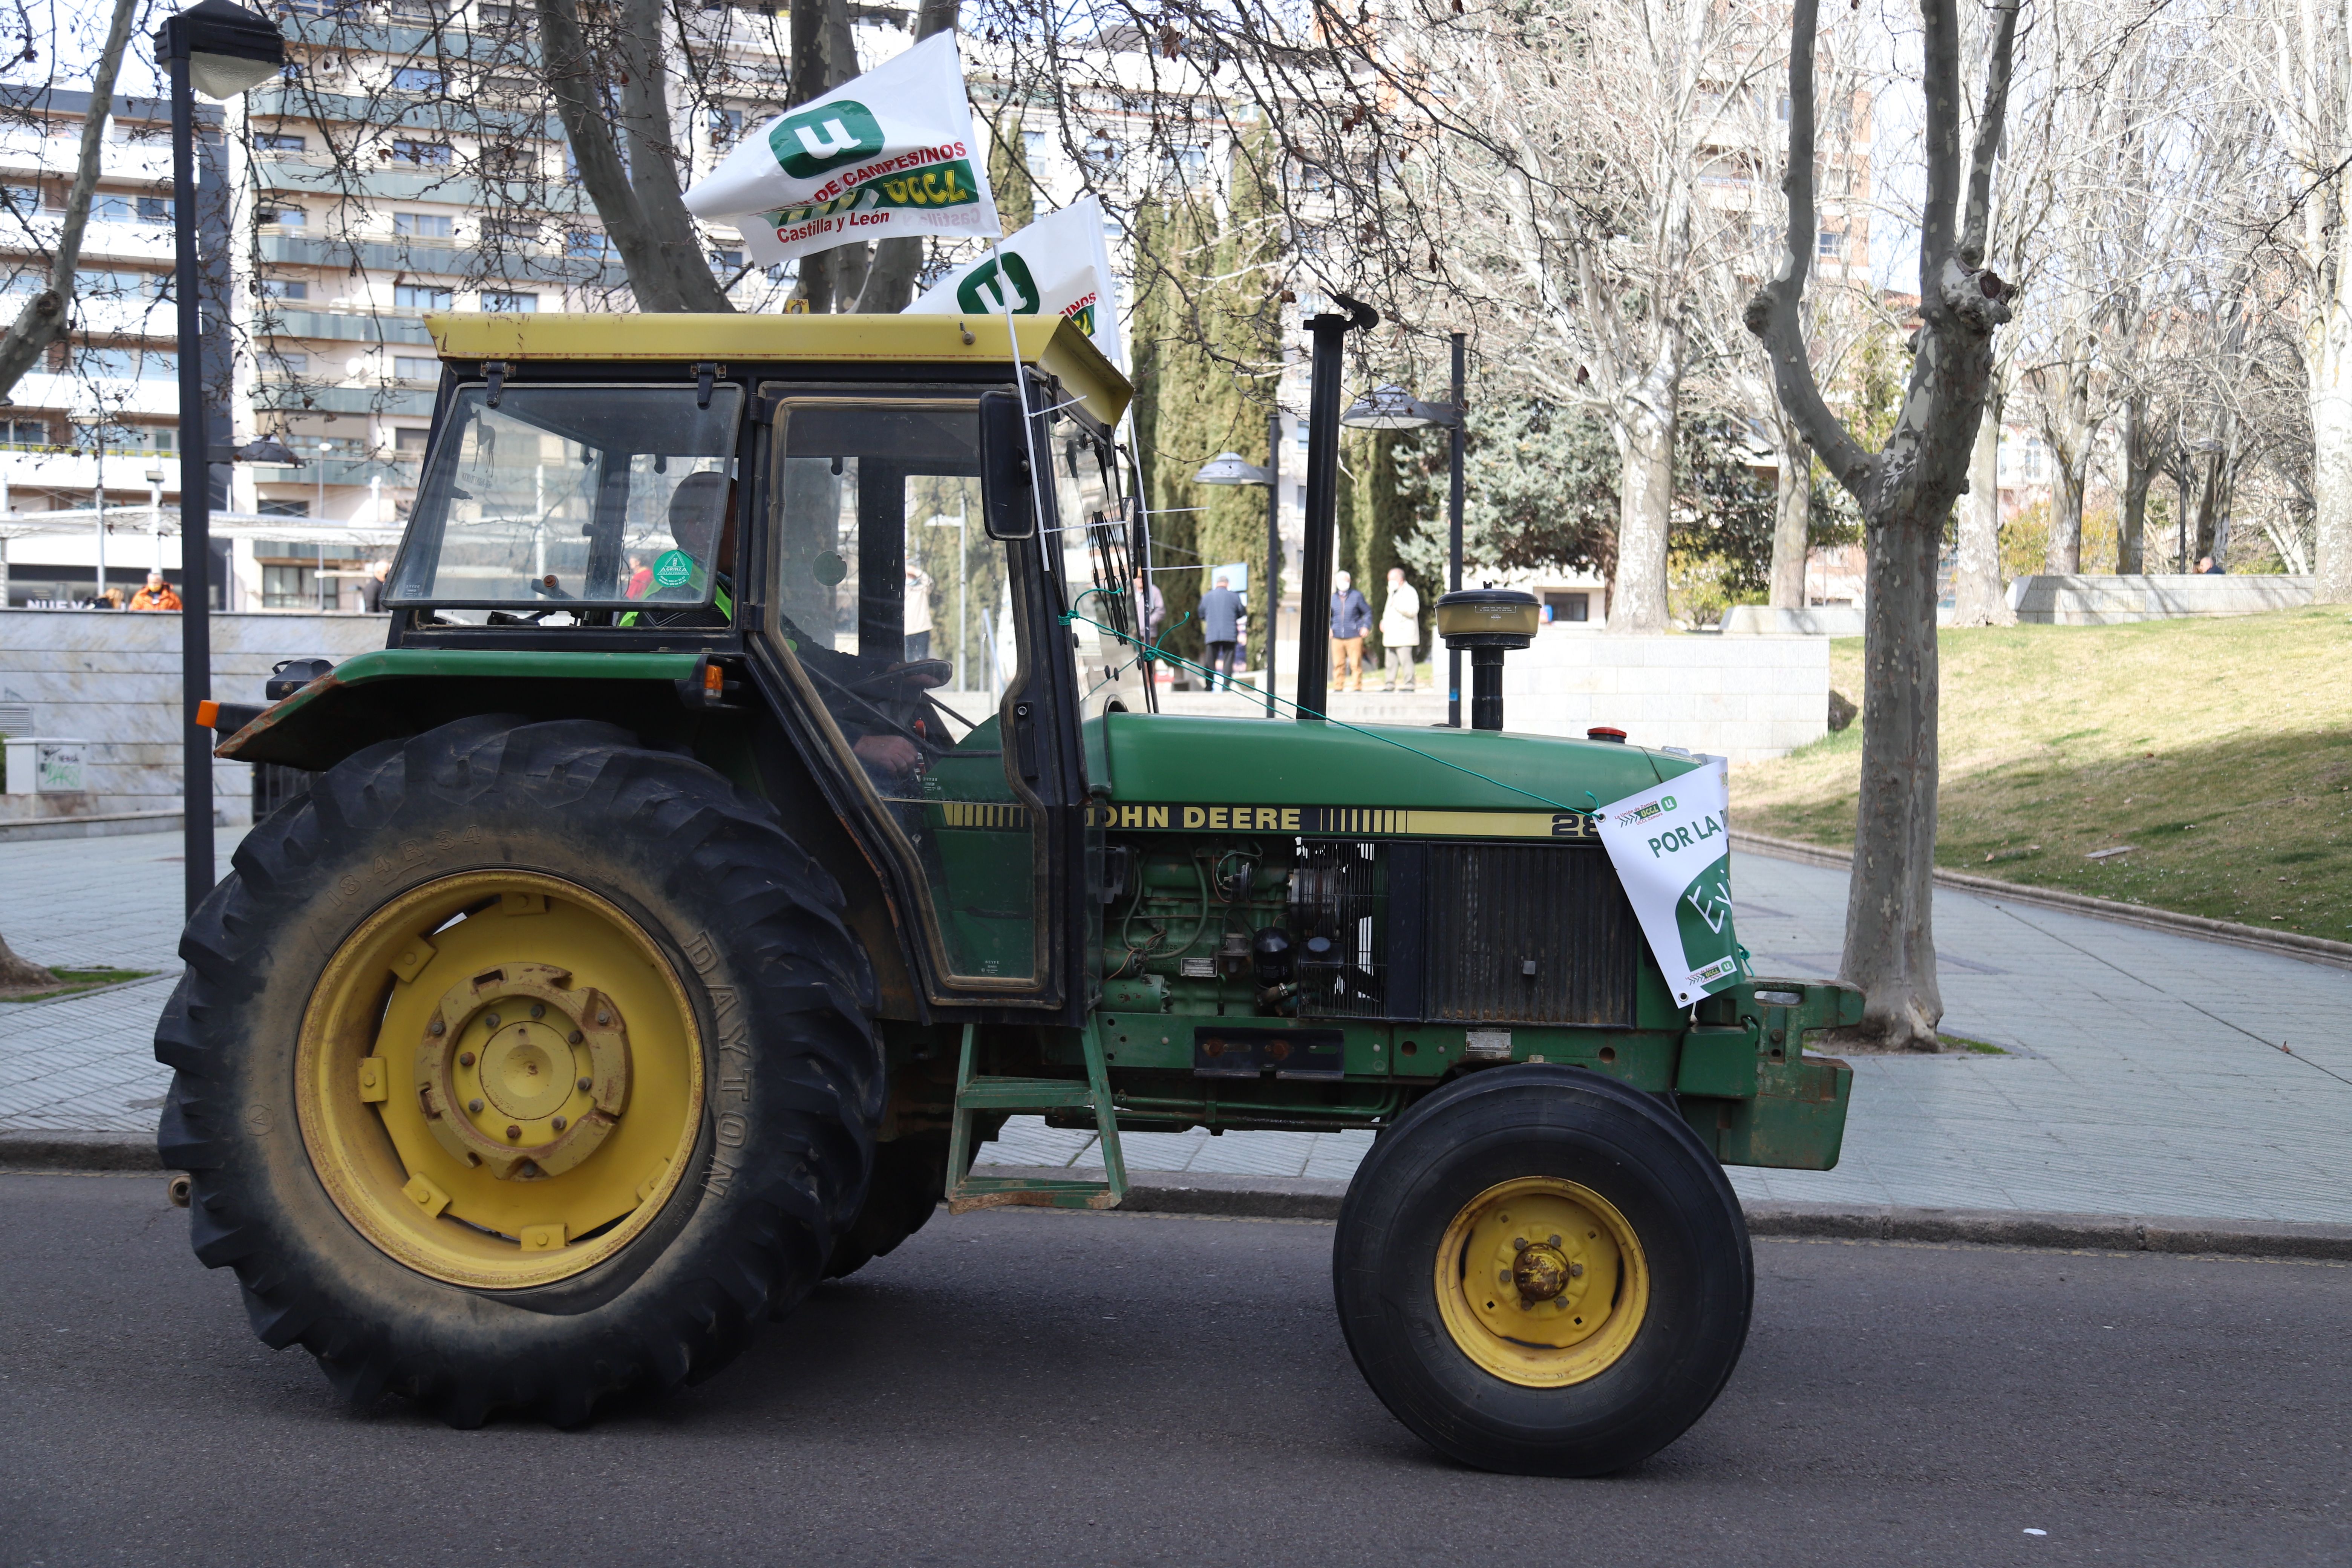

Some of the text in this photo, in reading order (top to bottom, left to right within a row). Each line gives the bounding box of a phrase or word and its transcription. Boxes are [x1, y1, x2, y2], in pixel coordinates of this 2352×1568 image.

[814, 141, 967, 203] DE CAMPESINOS
[884, 169, 968, 205] UCCL
[776, 210, 890, 243] Castilla y León
[1183, 807, 1301, 830] DEERE
[1640, 805, 1659, 818] UCCL
[1641, 800, 1657, 809] Zamora
[1648, 812, 1663, 821] Zamora
[1648, 826, 1695, 858] POR
[1692, 815, 1723, 840] LA
[1705, 968, 1719, 977] UCCL
[681, 930, 752, 1199] DAYTON
